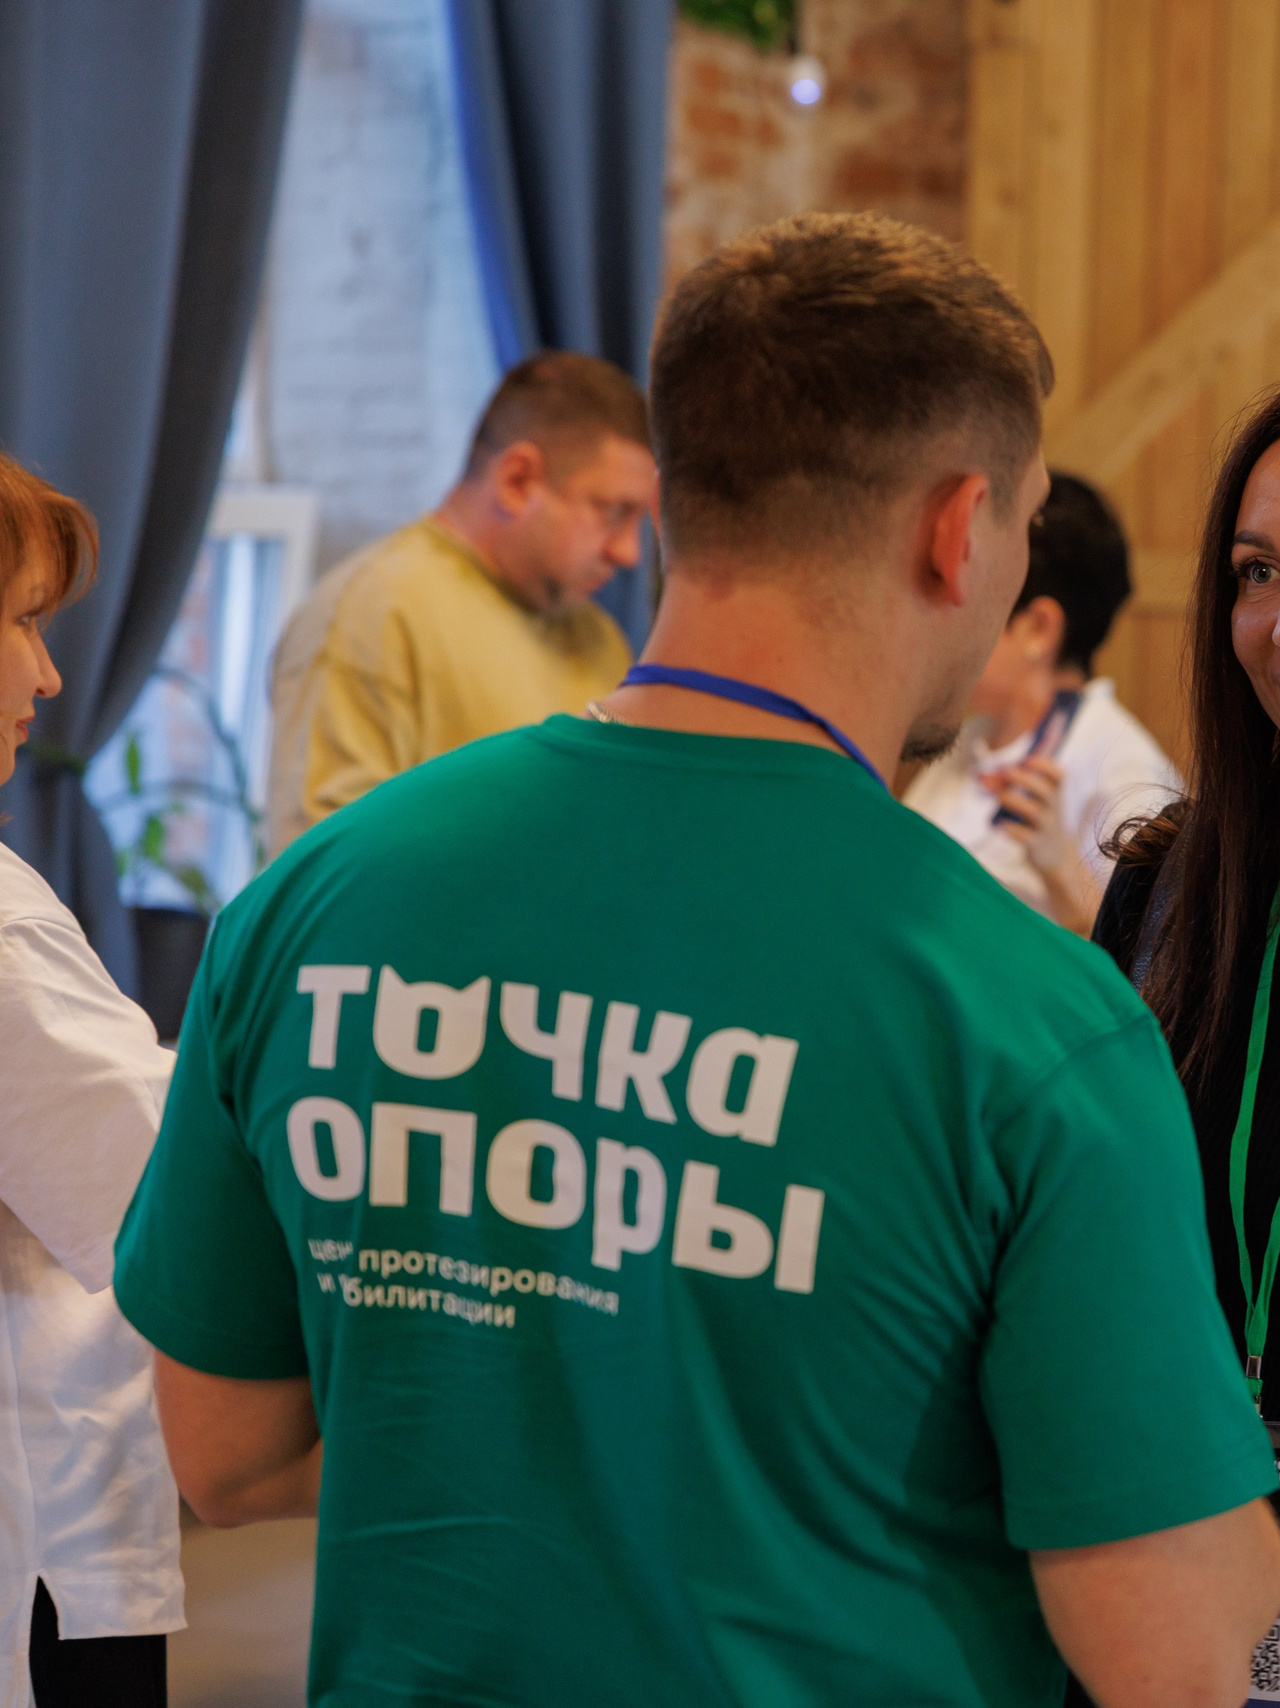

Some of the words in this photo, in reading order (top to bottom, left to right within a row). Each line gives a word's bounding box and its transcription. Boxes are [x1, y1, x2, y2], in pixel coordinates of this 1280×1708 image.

[286, 1096, 825, 1294] опоры
[338, 1273, 516, 1329] билитации
[358, 1248, 620, 1316] протезирования
